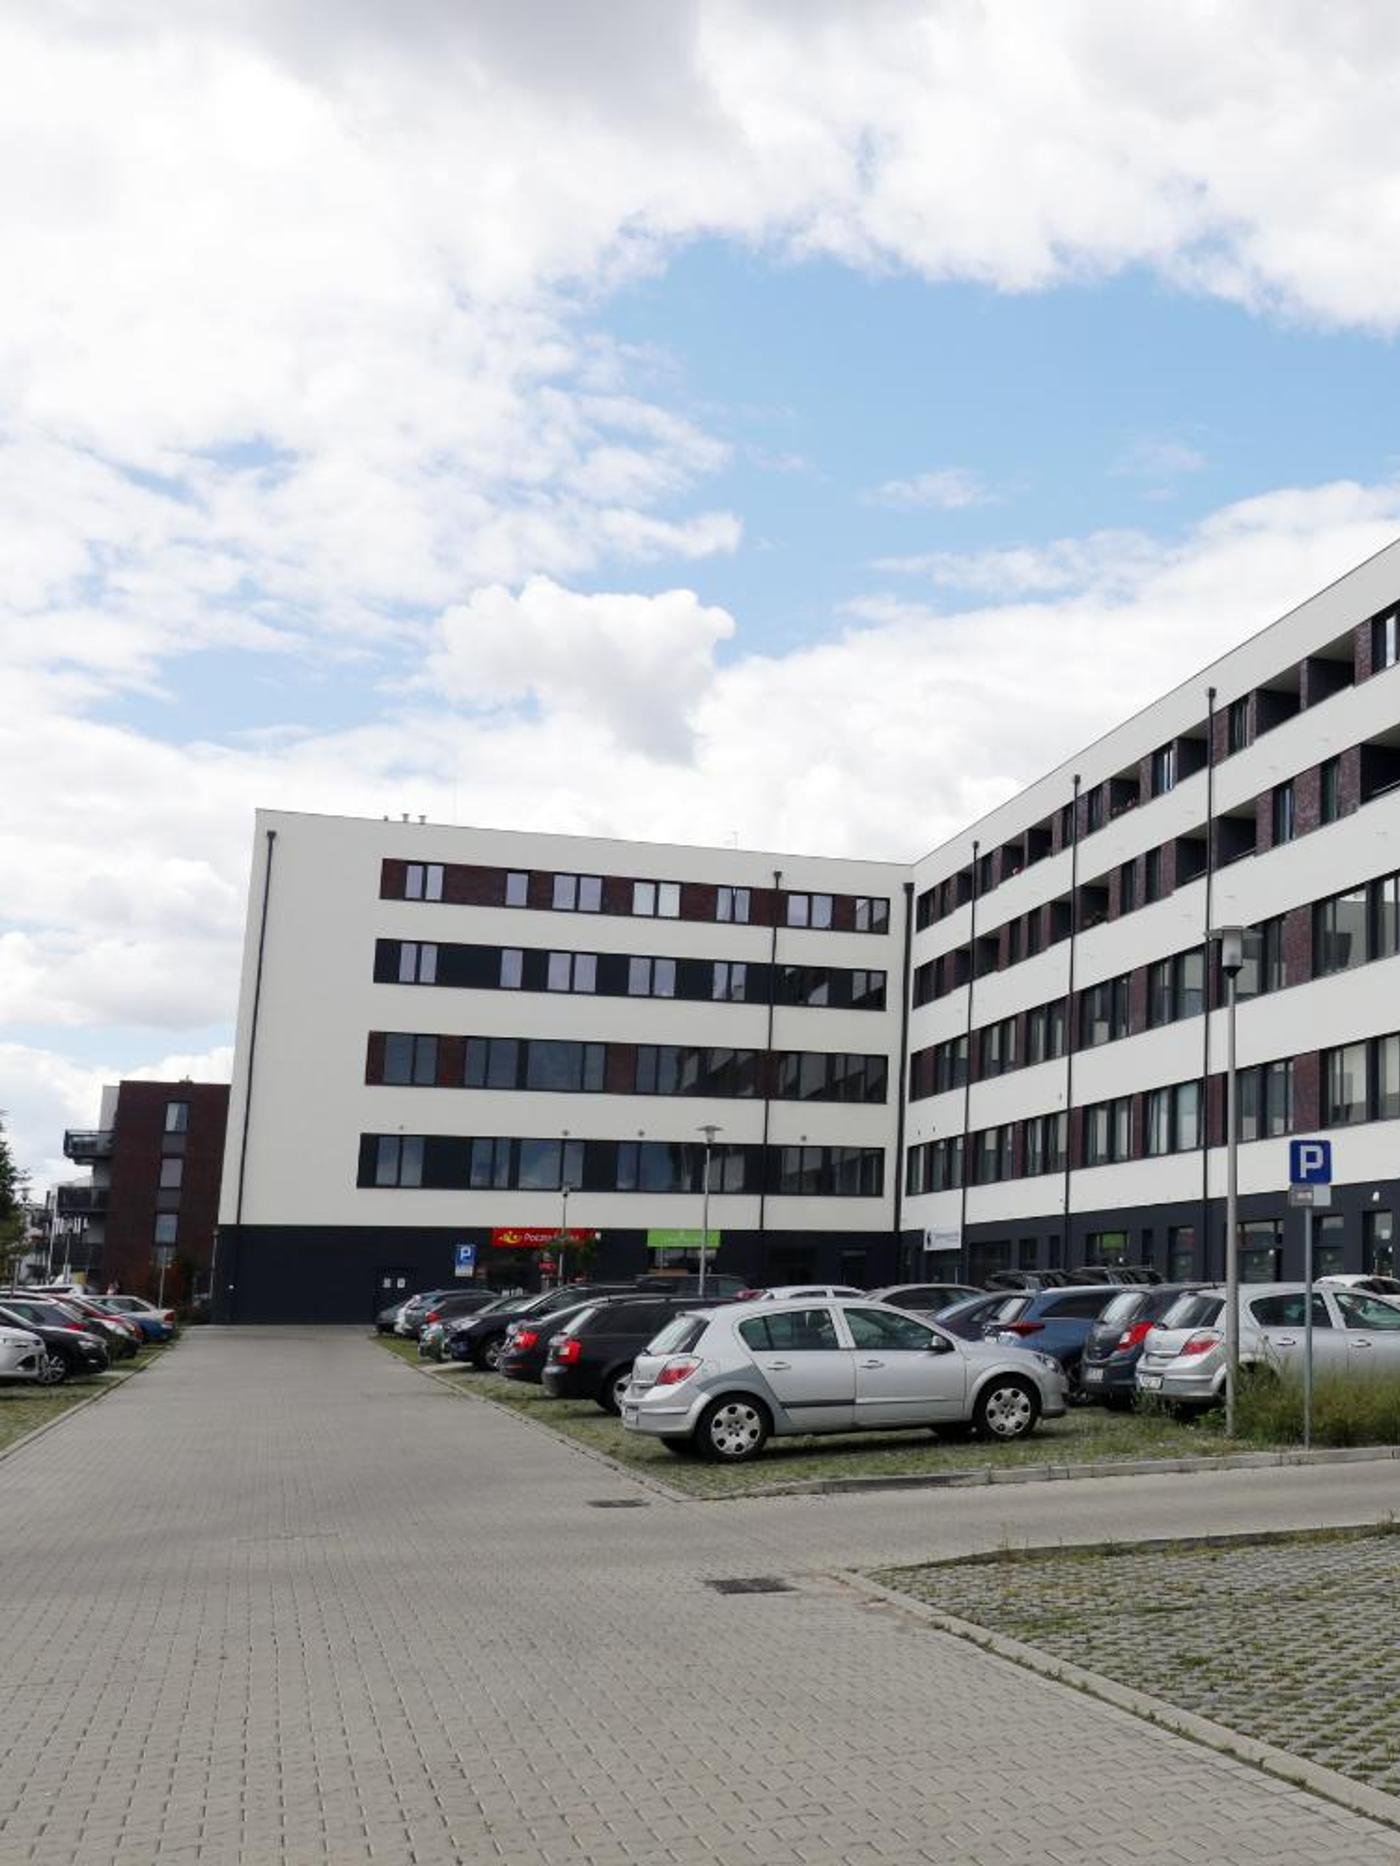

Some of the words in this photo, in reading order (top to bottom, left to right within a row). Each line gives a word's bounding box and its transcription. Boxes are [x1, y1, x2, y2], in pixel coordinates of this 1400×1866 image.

[1300, 1145, 1324, 1178] P
[524, 1232, 552, 1242] Pocz
[460, 1246, 471, 1261] P
